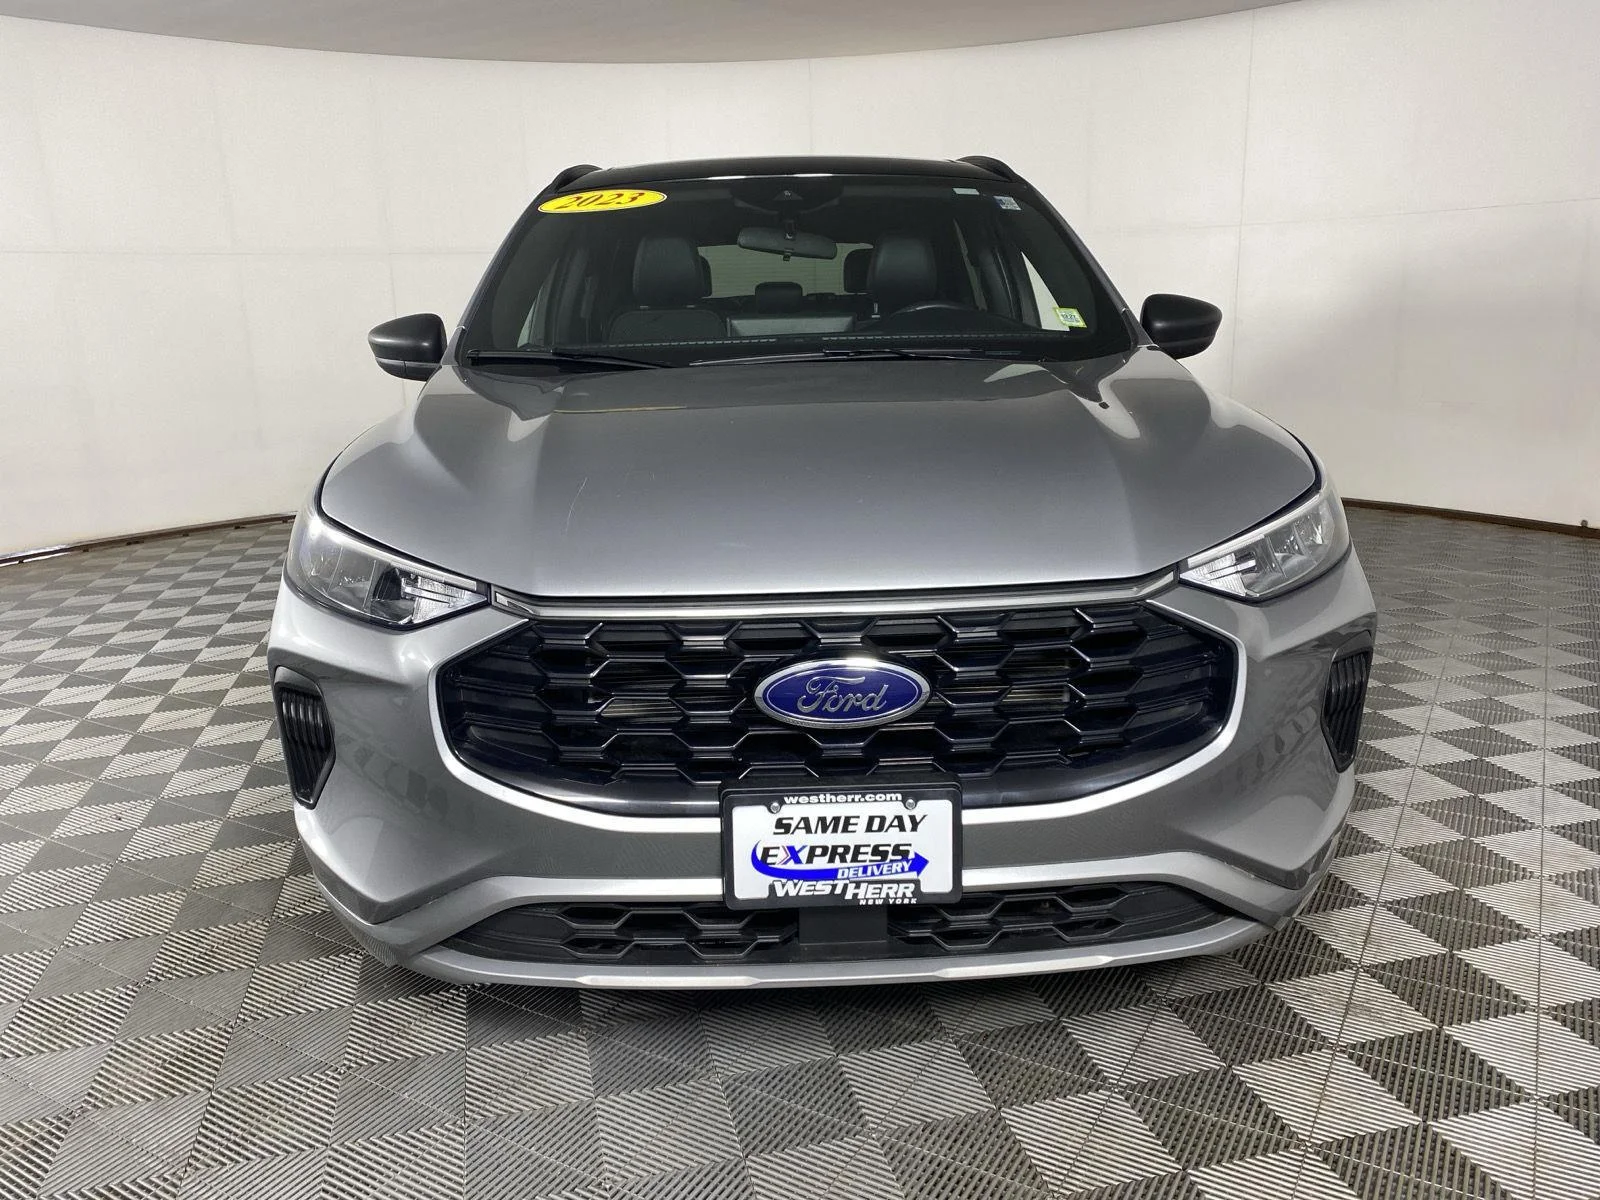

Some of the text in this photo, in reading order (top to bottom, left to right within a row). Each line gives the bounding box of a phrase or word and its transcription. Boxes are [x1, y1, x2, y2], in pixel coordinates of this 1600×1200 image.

[555, 192, 645, 209] 2023
[797, 676, 889, 713] Ford
[784, 792, 902, 804] westherr.com
[773, 814, 928, 835] SAME DAY
[760, 843, 912, 865] EXPRESS
[837, 861, 912, 879] DELIVERY
